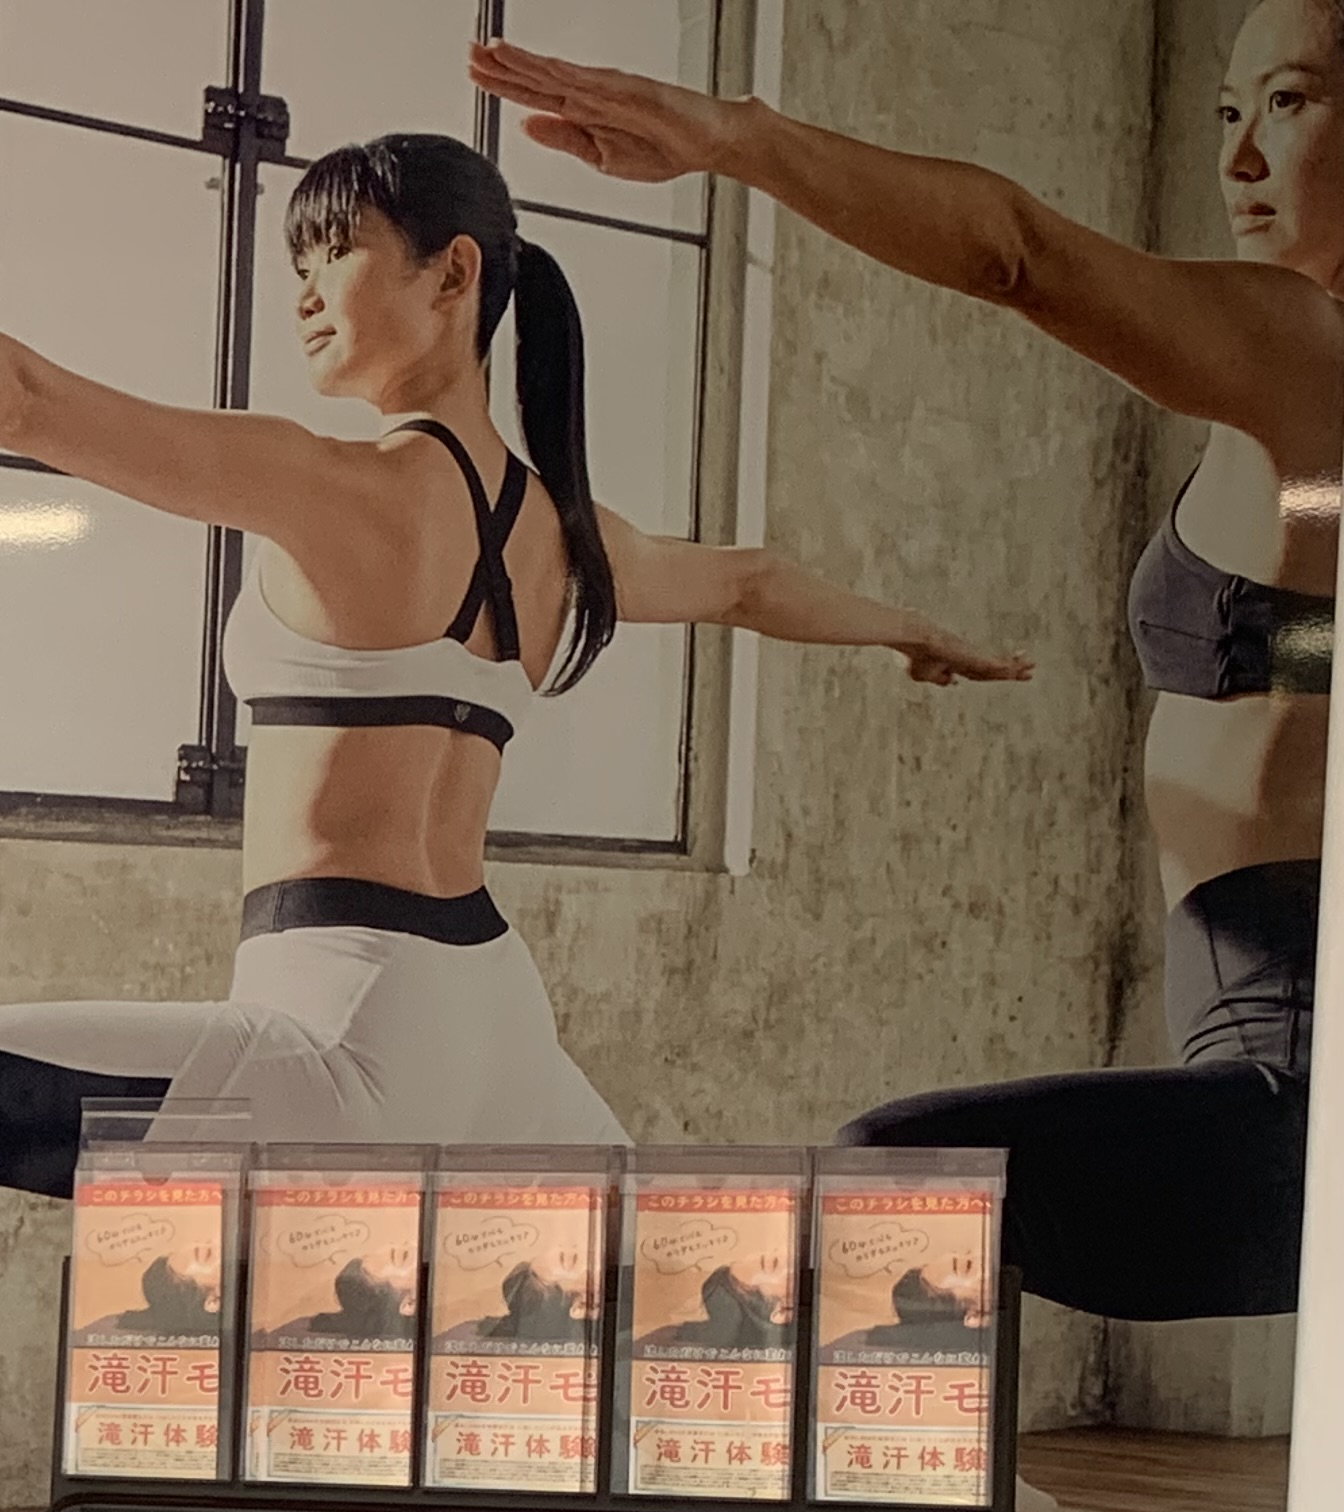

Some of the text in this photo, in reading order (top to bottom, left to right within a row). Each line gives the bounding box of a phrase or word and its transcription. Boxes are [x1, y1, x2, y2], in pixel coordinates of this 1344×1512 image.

[97, 1421, 218, 1448] 滝汗体験
[289, 1425, 412, 1453] 滝汗体験
[455, 1431, 597, 1460] 滝汗体験
[655, 1437, 790, 1466] 滝汗体験
[847, 1443, 987, 1472] 滝汗体験
